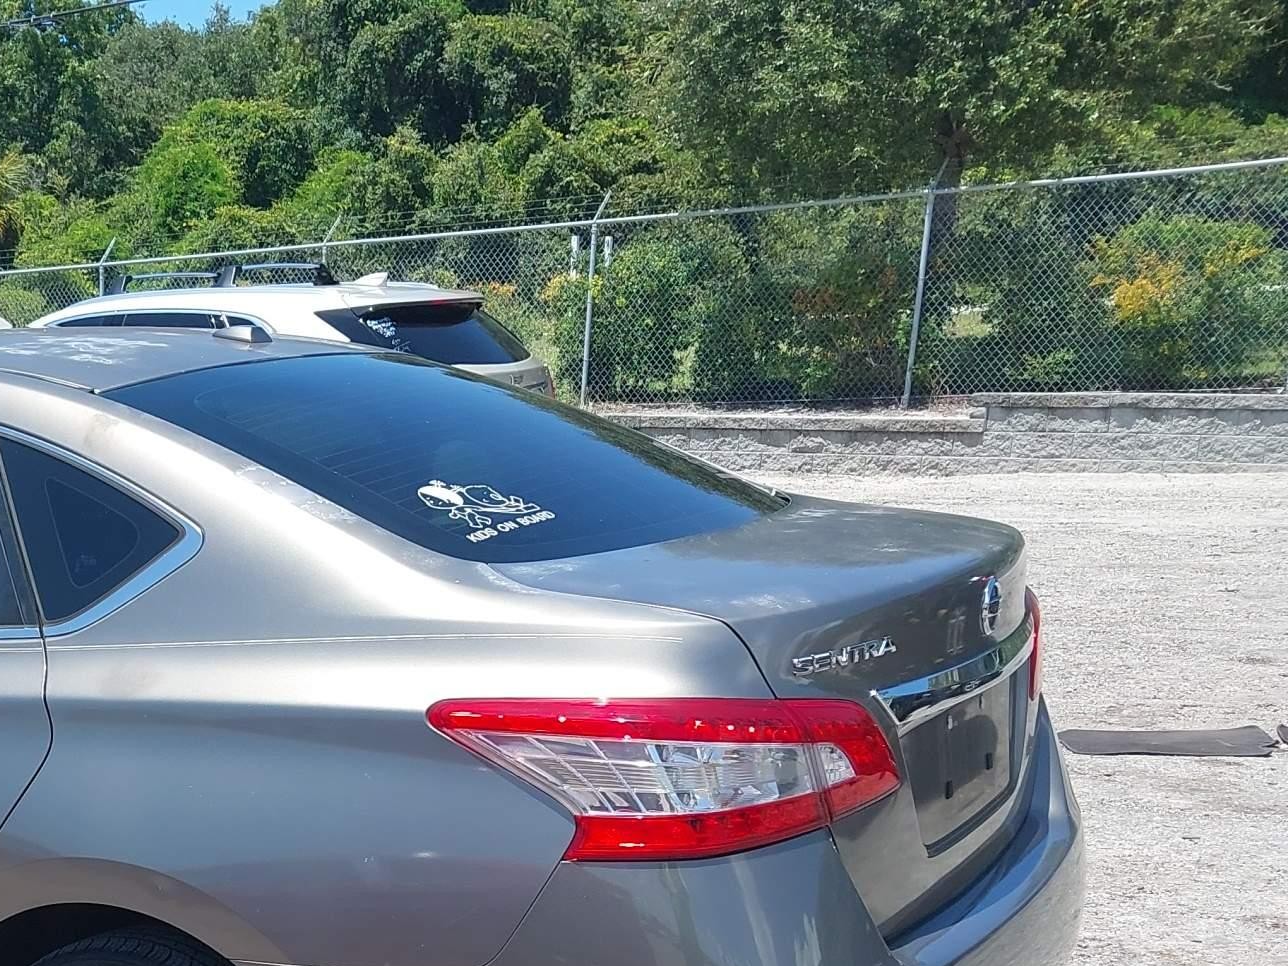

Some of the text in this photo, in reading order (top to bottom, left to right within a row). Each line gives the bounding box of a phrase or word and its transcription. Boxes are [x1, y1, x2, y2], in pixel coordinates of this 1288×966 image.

[465, 510, 556, 543] KIDS ON BOARD
[791, 635, 898, 677] SENTRA
